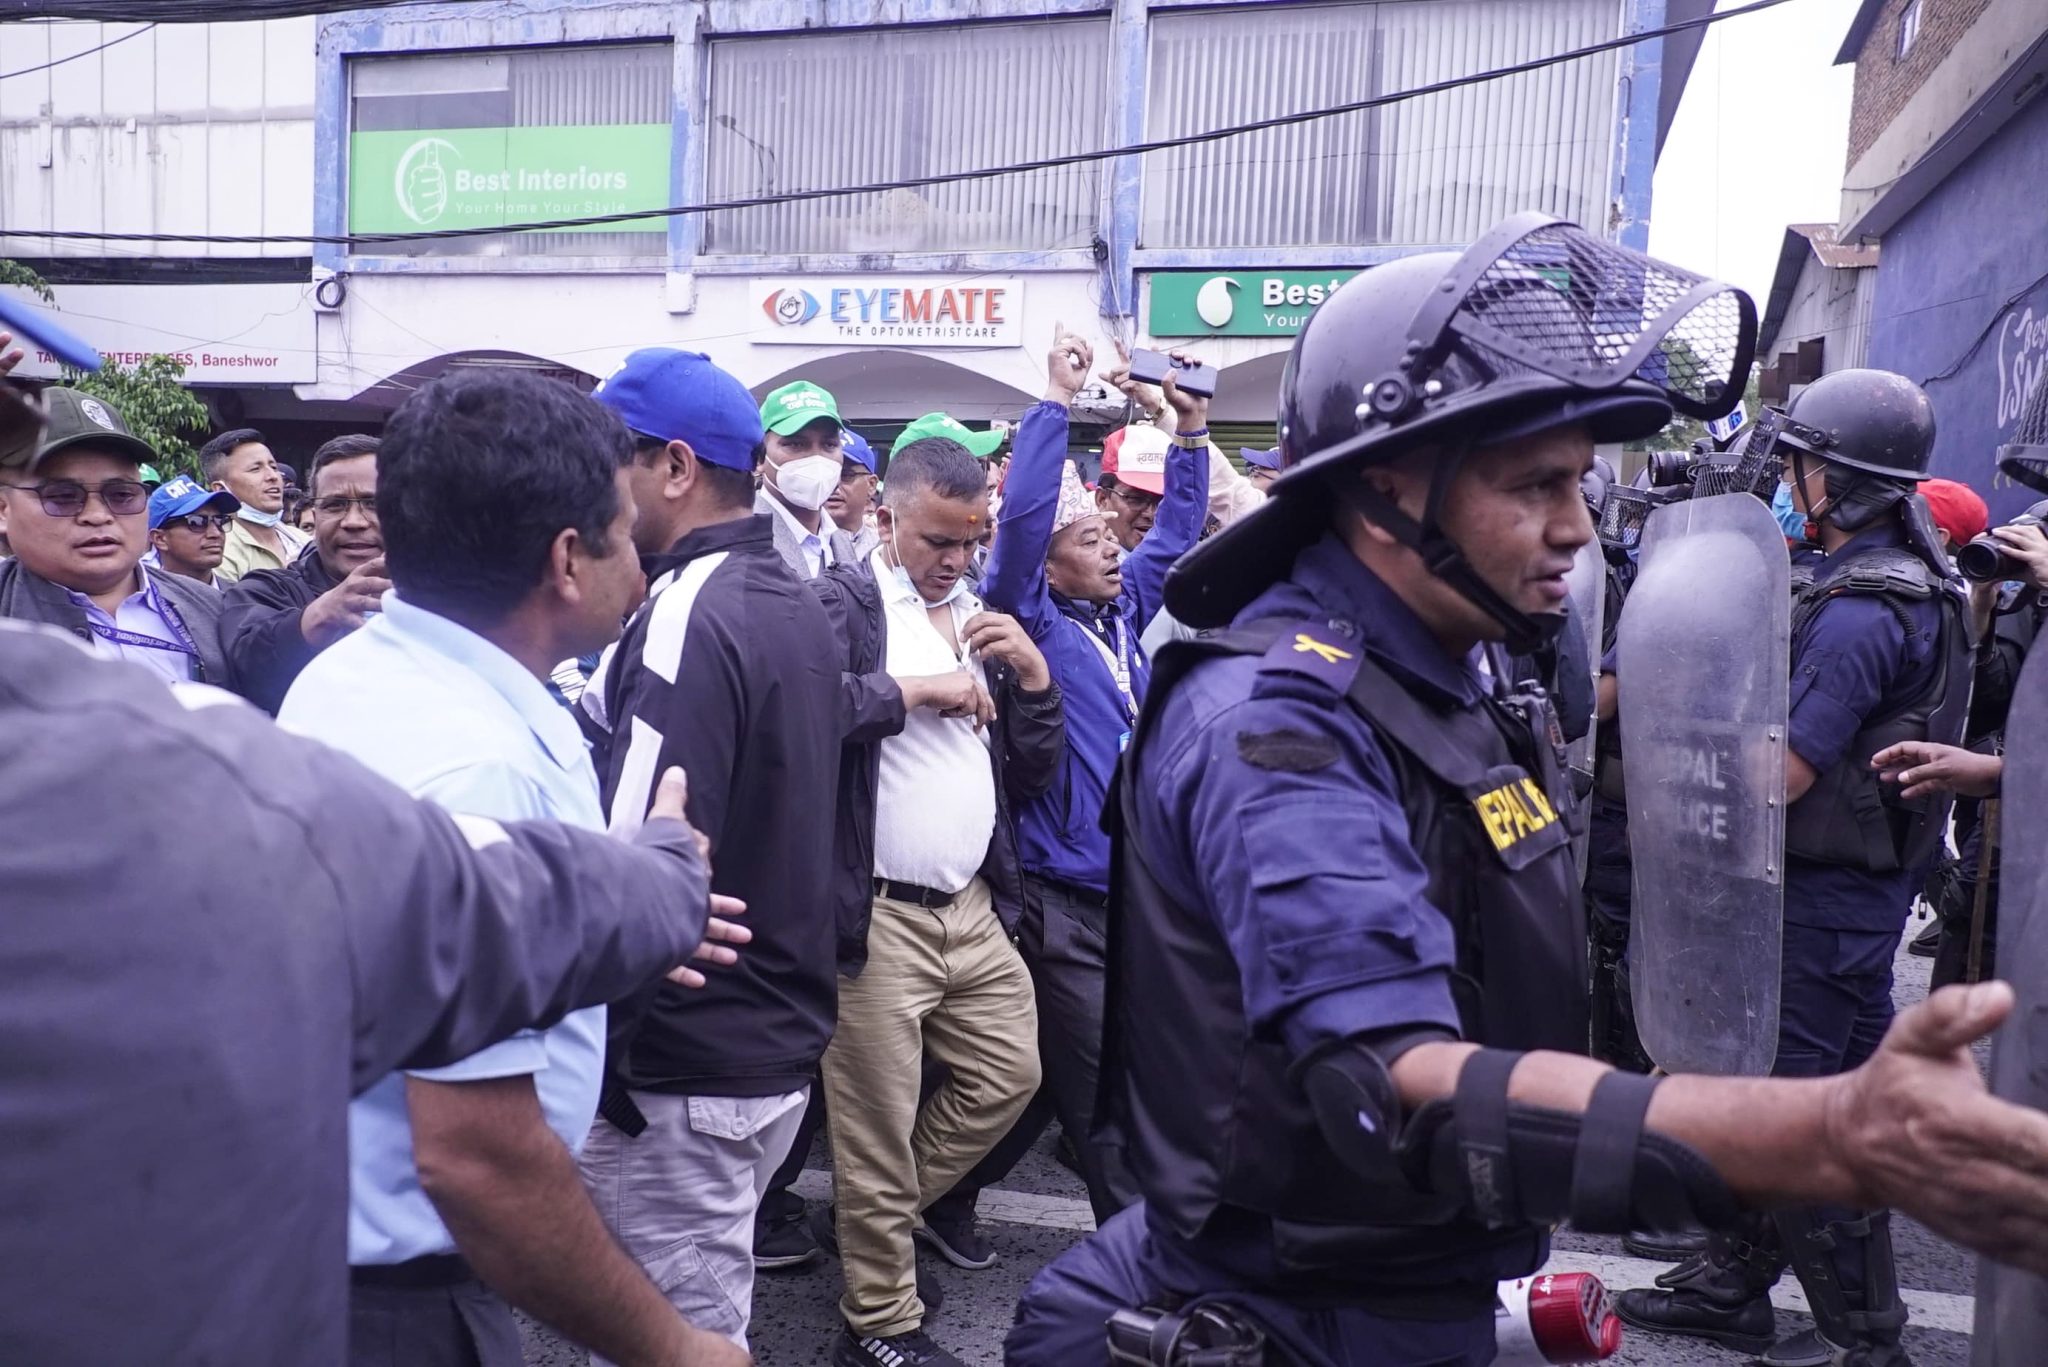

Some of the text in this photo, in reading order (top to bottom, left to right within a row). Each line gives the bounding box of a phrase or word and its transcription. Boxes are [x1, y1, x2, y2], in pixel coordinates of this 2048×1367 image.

[455, 165, 627, 192] Best Interiors
[456, 202, 490, 214] Your
[495, 203, 538, 214] Home
[543, 202, 580, 214] Your
[830, 288, 1006, 324] EYEMATE
[1263, 313, 1308, 328] Your
[839, 326, 862, 336] THE
[202, 354, 279, 367] Baneshwor
